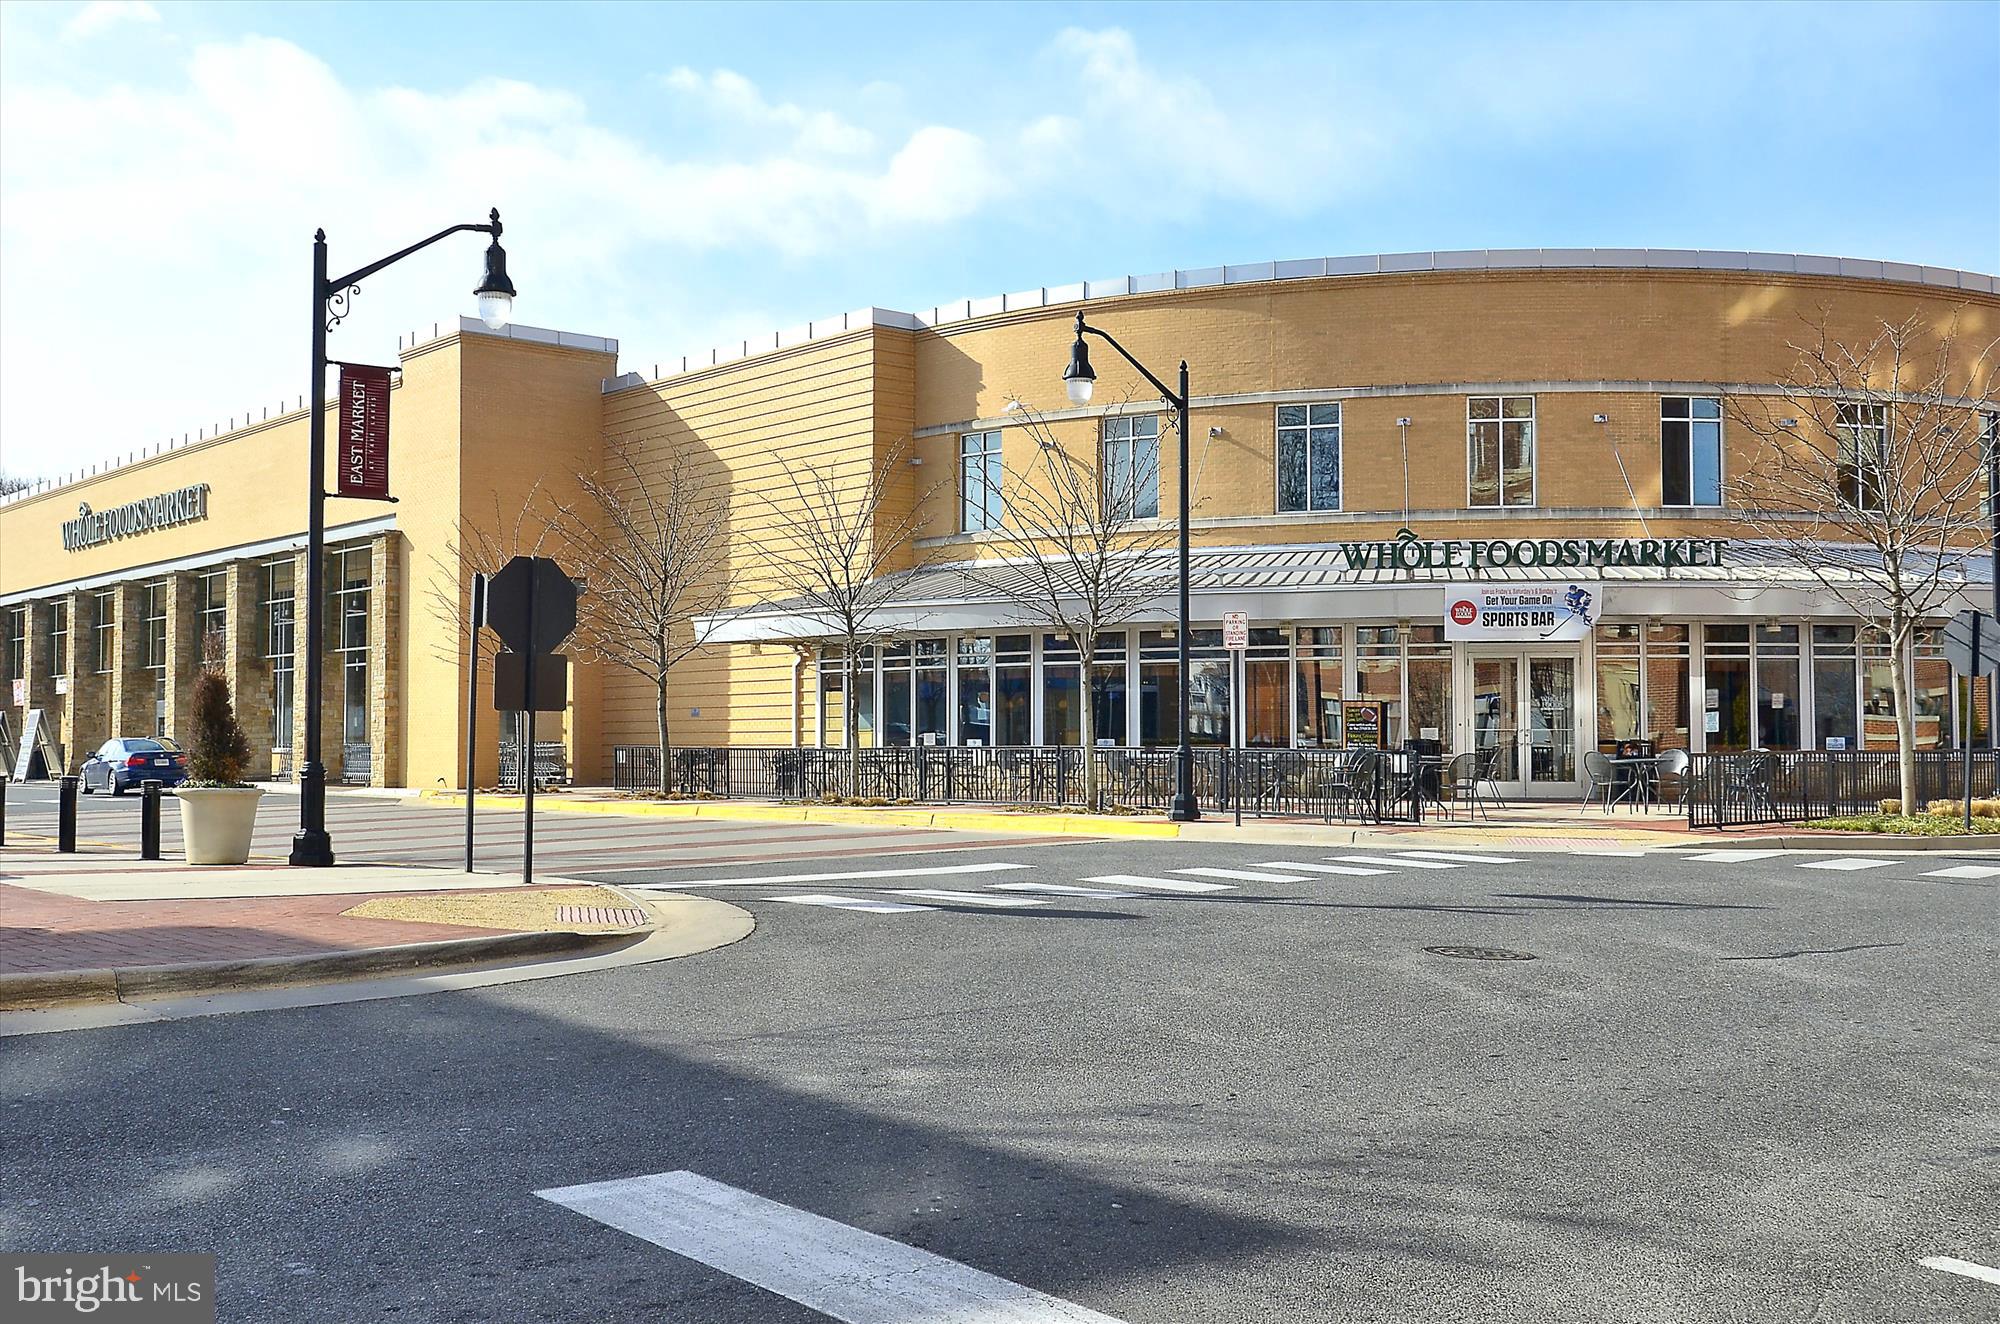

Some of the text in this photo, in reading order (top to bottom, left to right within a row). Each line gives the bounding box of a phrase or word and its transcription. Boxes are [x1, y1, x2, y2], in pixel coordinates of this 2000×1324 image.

[350, 380, 366, 485] EAST MARKET
[62, 482, 209, 550] WHOLE FOODS MARKET
[1340, 531, 1730, 570] WHOLE FOODS MARKET
[1482, 611, 1555, 627] SPORTS BAR
[1485, 594, 1552, 606] Get Your Game On
